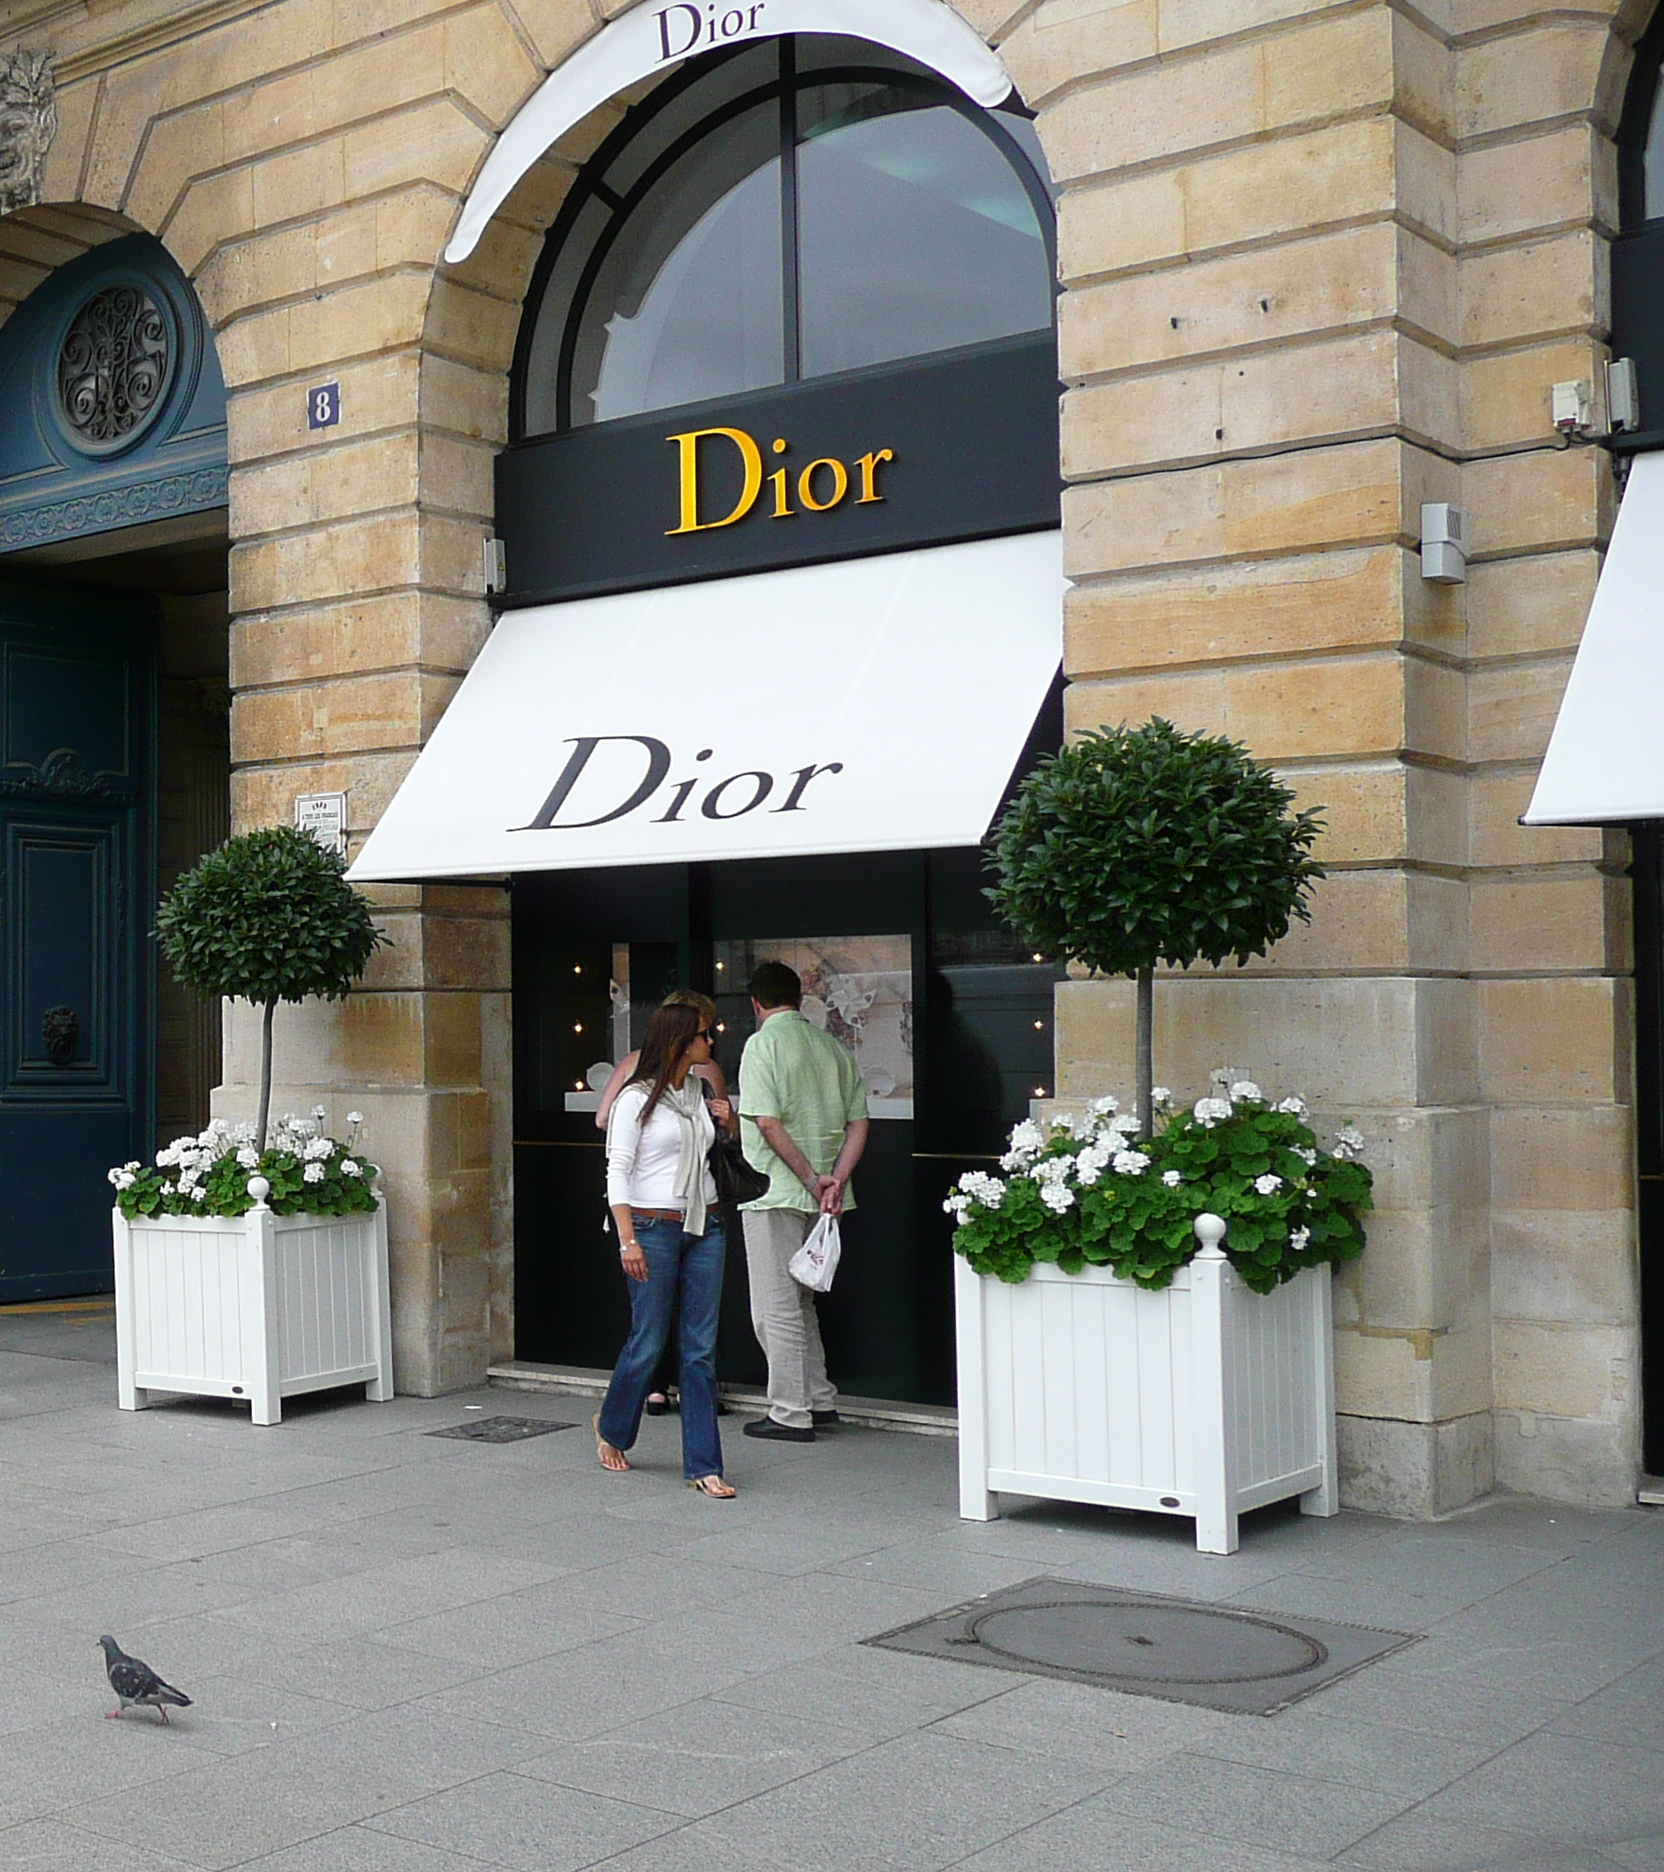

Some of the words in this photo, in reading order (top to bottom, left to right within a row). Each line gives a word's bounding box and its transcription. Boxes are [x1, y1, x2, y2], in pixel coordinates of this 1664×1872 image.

[651, 2, 765, 64] Dior
[316, 391, 331, 422] 8
[664, 427, 894, 536] Dior
[505, 735, 844, 832] Dior
